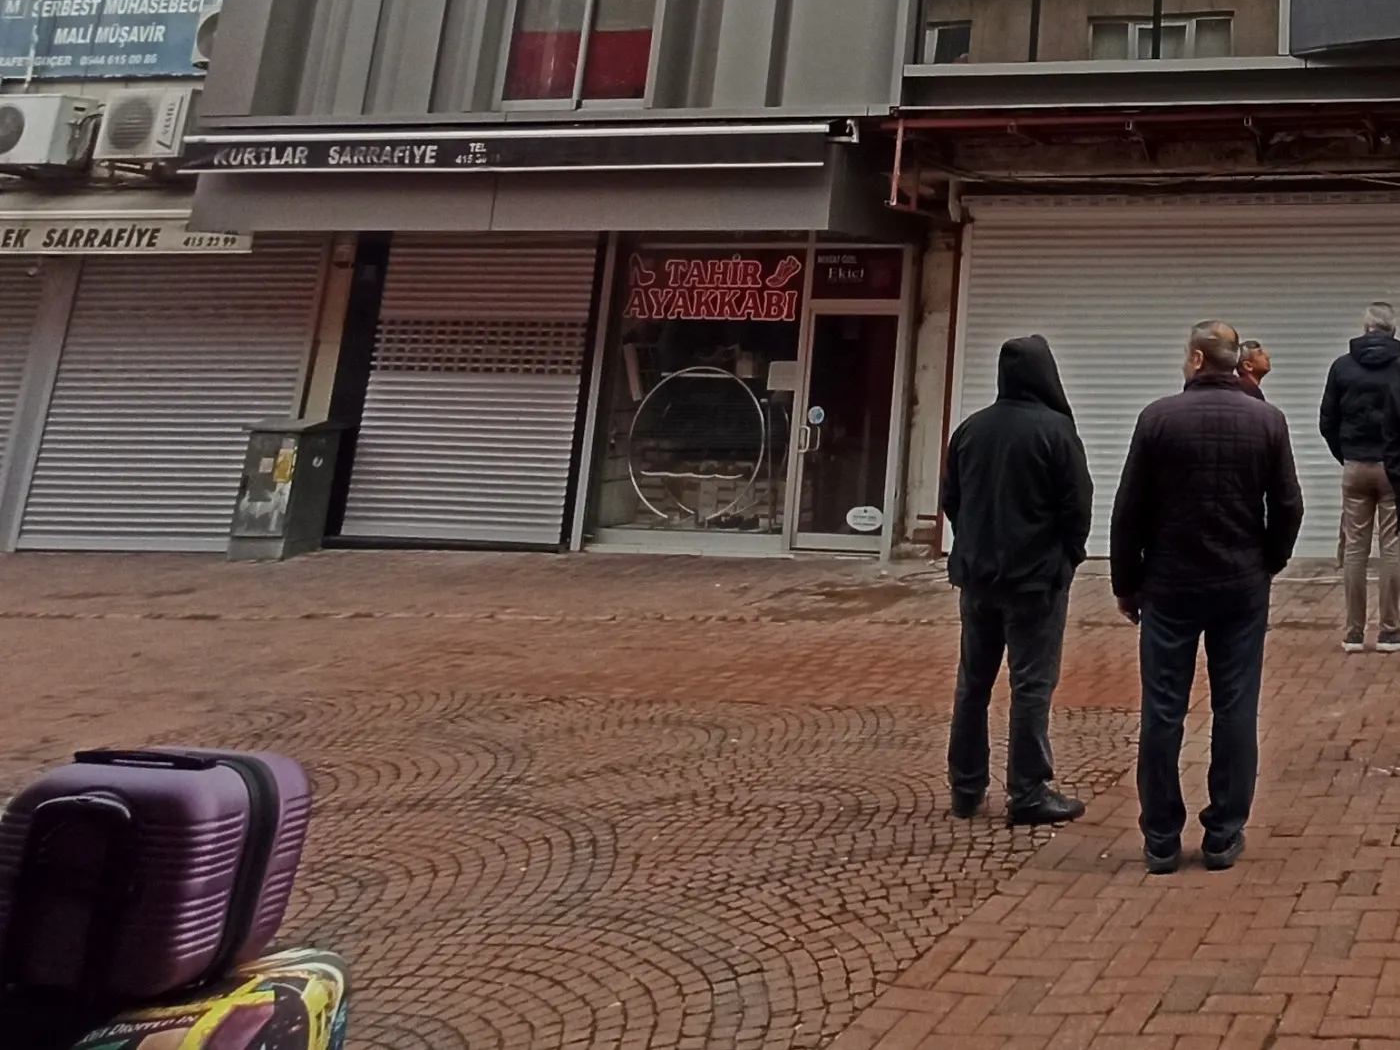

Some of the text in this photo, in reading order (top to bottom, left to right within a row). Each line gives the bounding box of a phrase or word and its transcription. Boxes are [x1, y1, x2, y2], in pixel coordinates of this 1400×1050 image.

[54, 22, 166, 47] MALİ MÜŞAVİR
[213, 145, 438, 166] KURTLAR SARRAFİYE
[469, 142, 487, 153] TEL
[42, 224, 162, 248] SARRAFİYE
[665, 253, 762, 287] TAHİR
[623, 288, 798, 322] AYAKKABI
